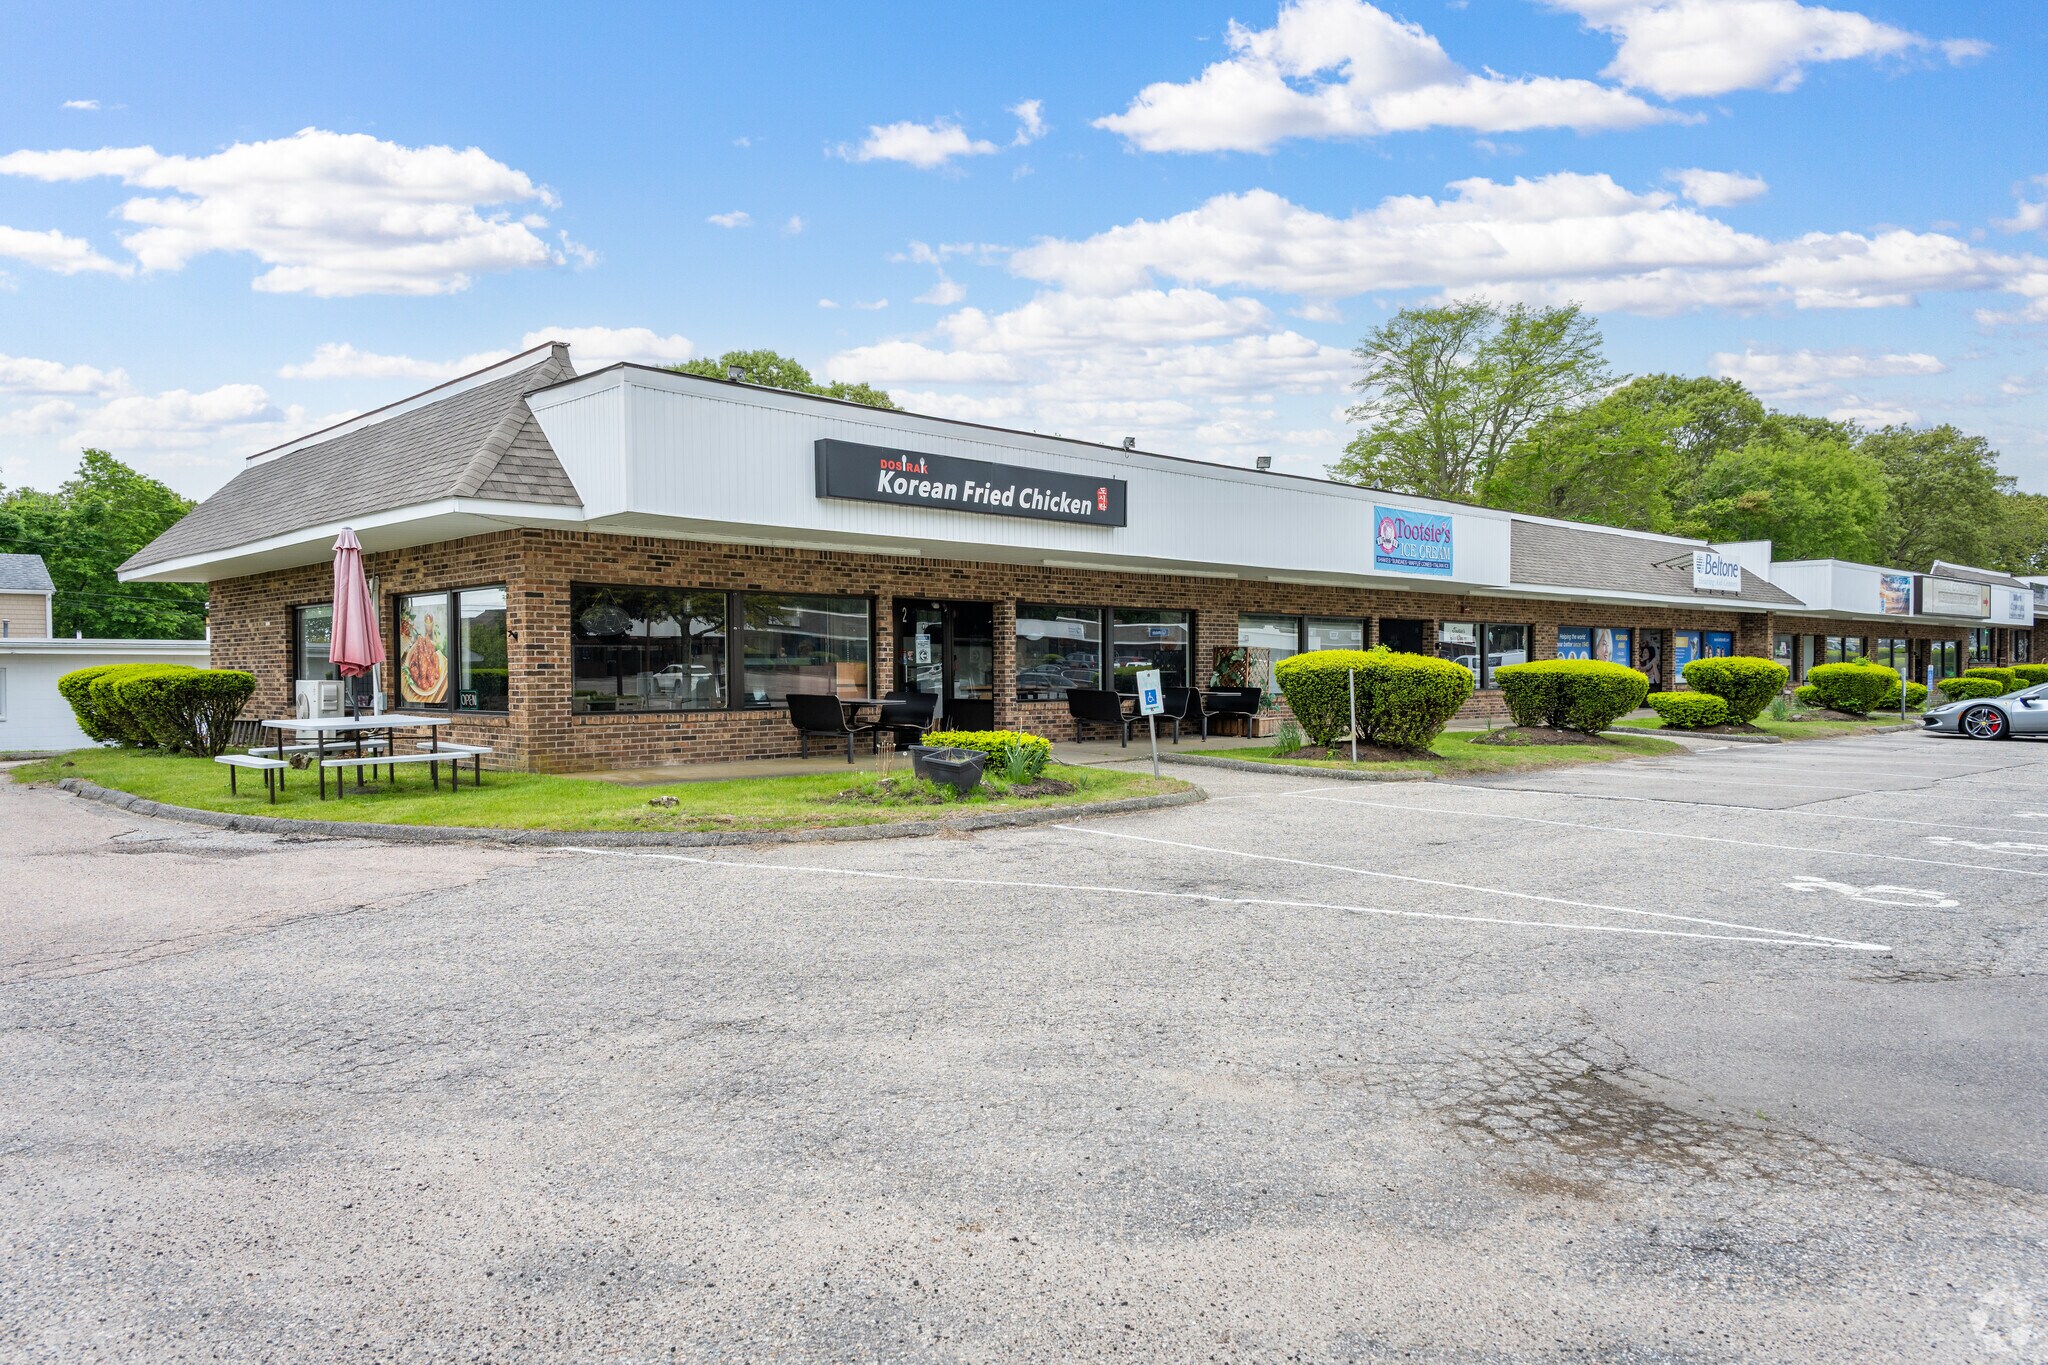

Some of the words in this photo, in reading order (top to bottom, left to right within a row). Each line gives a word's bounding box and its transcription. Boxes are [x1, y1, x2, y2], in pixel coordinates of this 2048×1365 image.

[877, 470, 958, 500] Korean
[962, 480, 1015, 507] Fried
[1019, 487, 1092, 515] Chicken
[1394, 517, 1451, 543] Tootsie's
[1401, 543, 1417, 557] ICE
[1419, 545, 1450, 560] CREAM
[1705, 553, 1739, 578] Beltone
[902, 607, 907, 622] 2
[461, 693, 477, 706] OPEN
